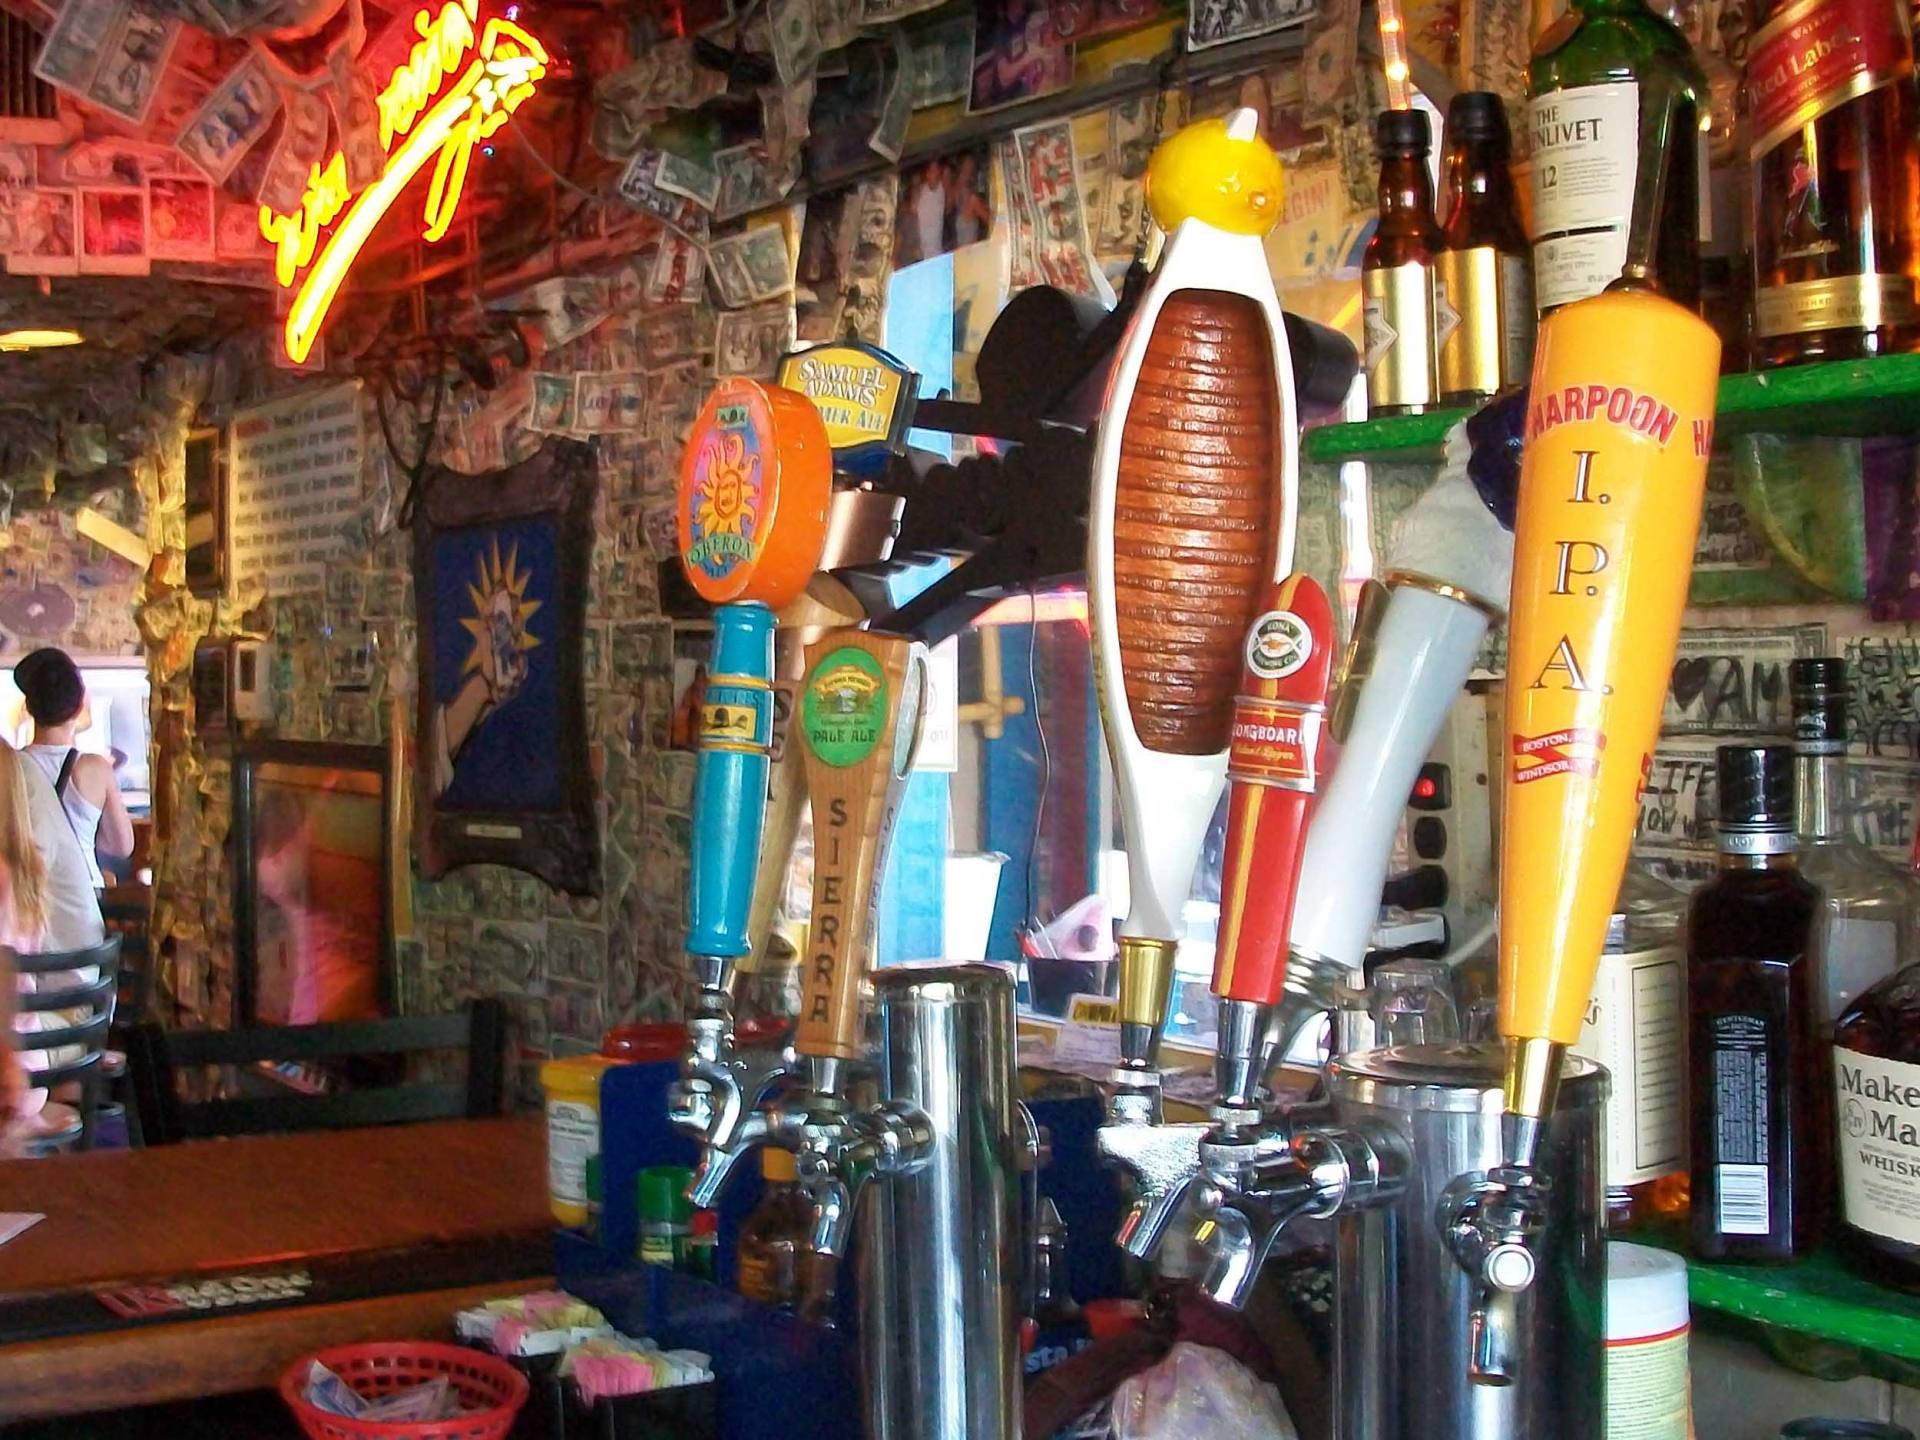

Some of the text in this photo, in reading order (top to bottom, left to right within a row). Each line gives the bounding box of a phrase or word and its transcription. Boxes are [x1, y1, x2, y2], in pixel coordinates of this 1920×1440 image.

[1535, 105, 1560, 124] THE
[1541, 165, 1558, 189] 12
[799, 357, 888, 391] SAMUEL
[803, 379, 878, 409] ADAMS
[1532, 384, 1680, 446] HARPOON
[689, 532, 755, 565] OBERON
[1266, 620, 1293, 634] KONA
[813, 728, 877, 743] PALE ALE
[808, 798, 848, 1024] SIERRA
[1840, 1062, 1920, 1109] Make
[1869, 1109, 1920, 1147] Ma
